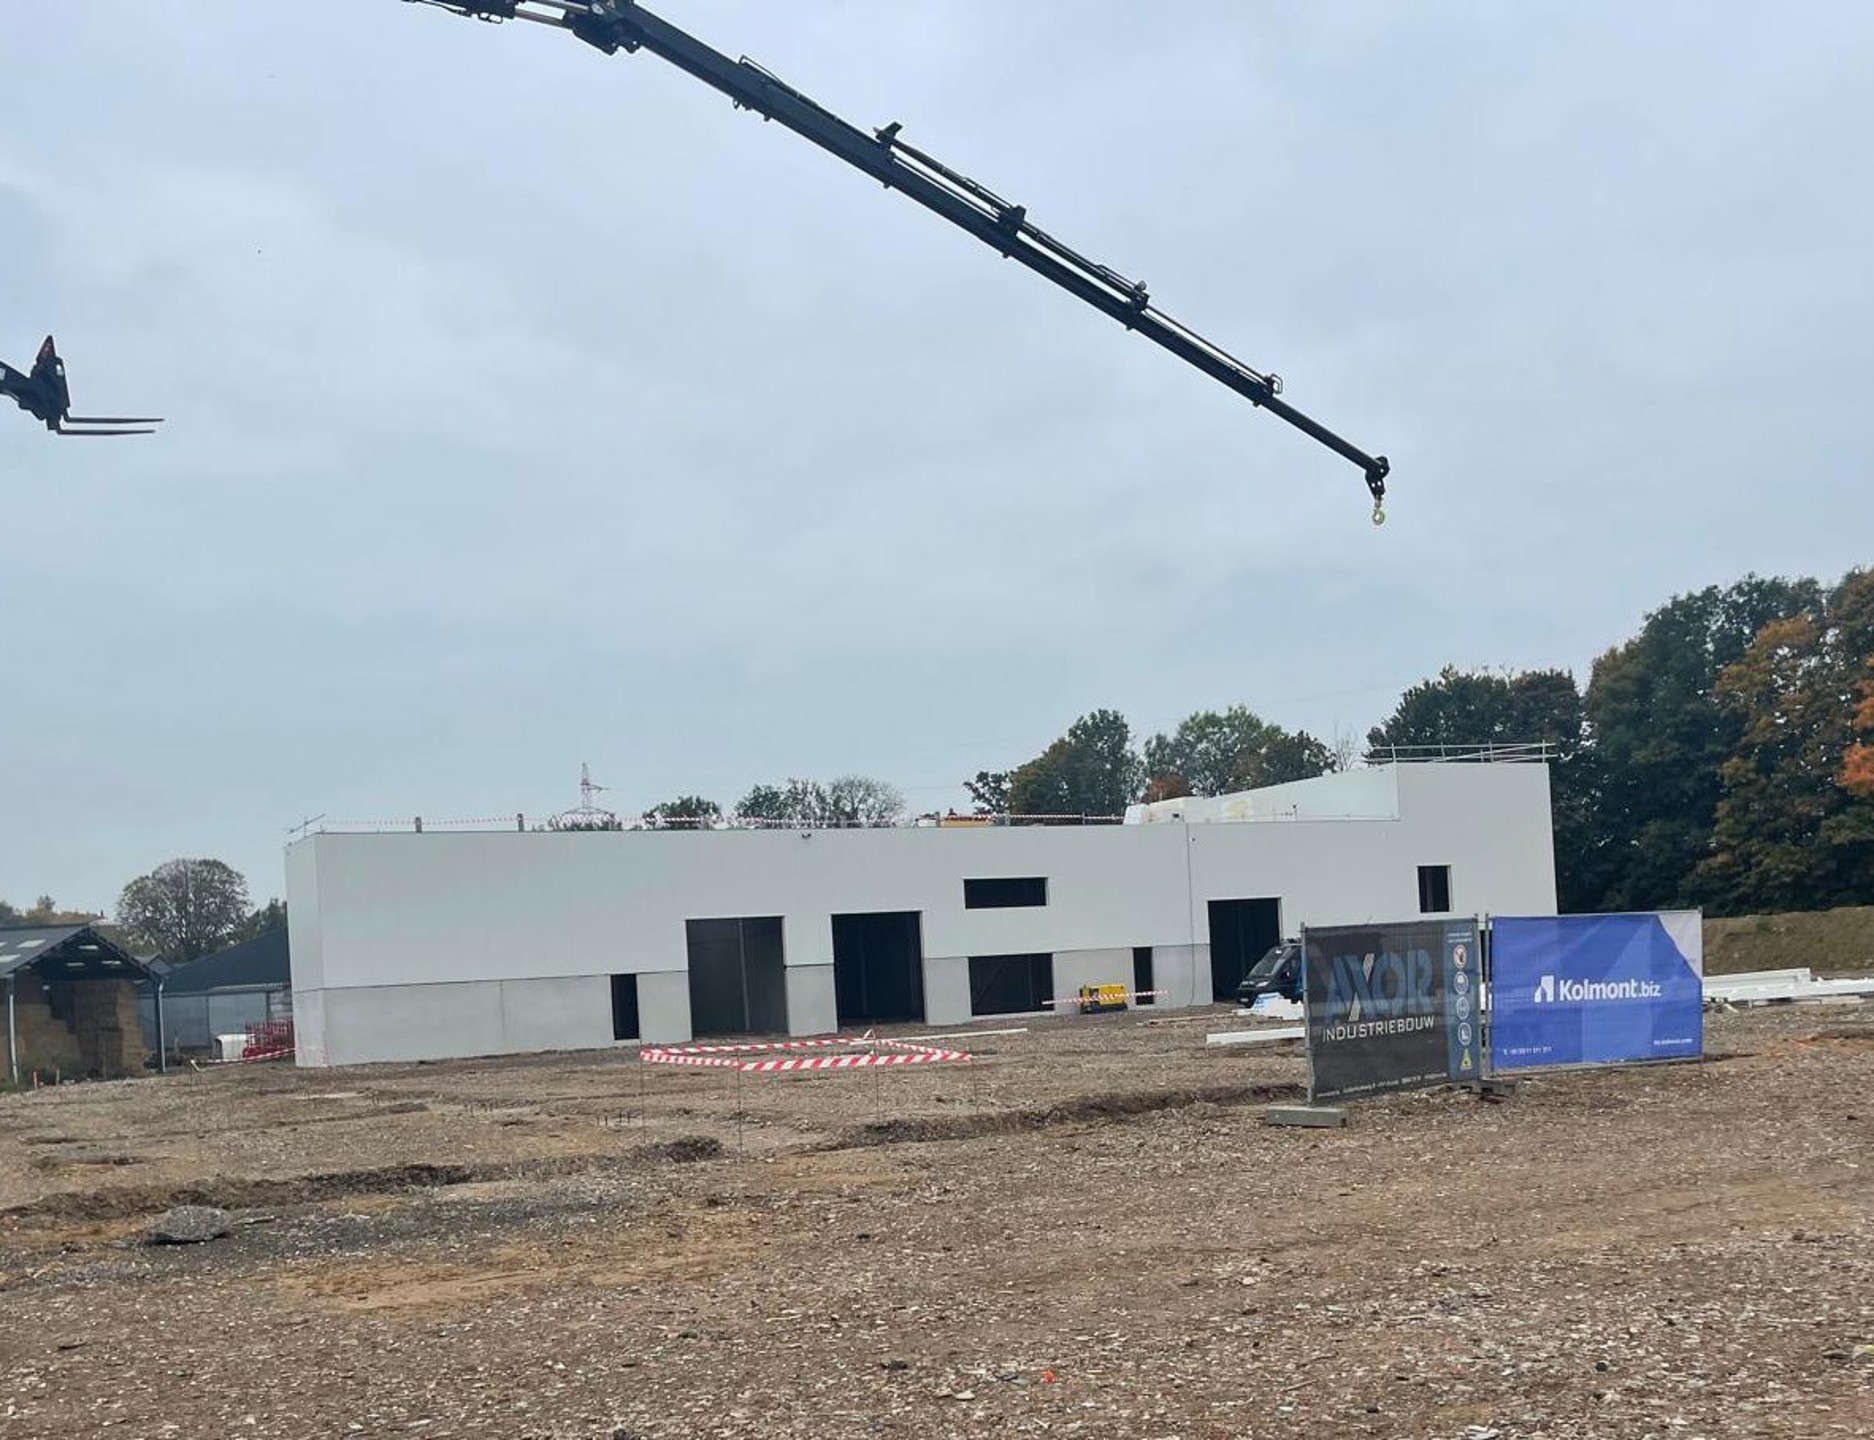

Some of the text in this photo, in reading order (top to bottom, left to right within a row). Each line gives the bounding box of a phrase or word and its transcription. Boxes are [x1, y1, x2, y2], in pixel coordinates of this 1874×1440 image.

[1325, 949, 1435, 1022] AXOR
[1559, 978, 1662, 1001] Kolmont.biz
[1322, 1015, 1435, 1043] INDUSTRIEBOUW
